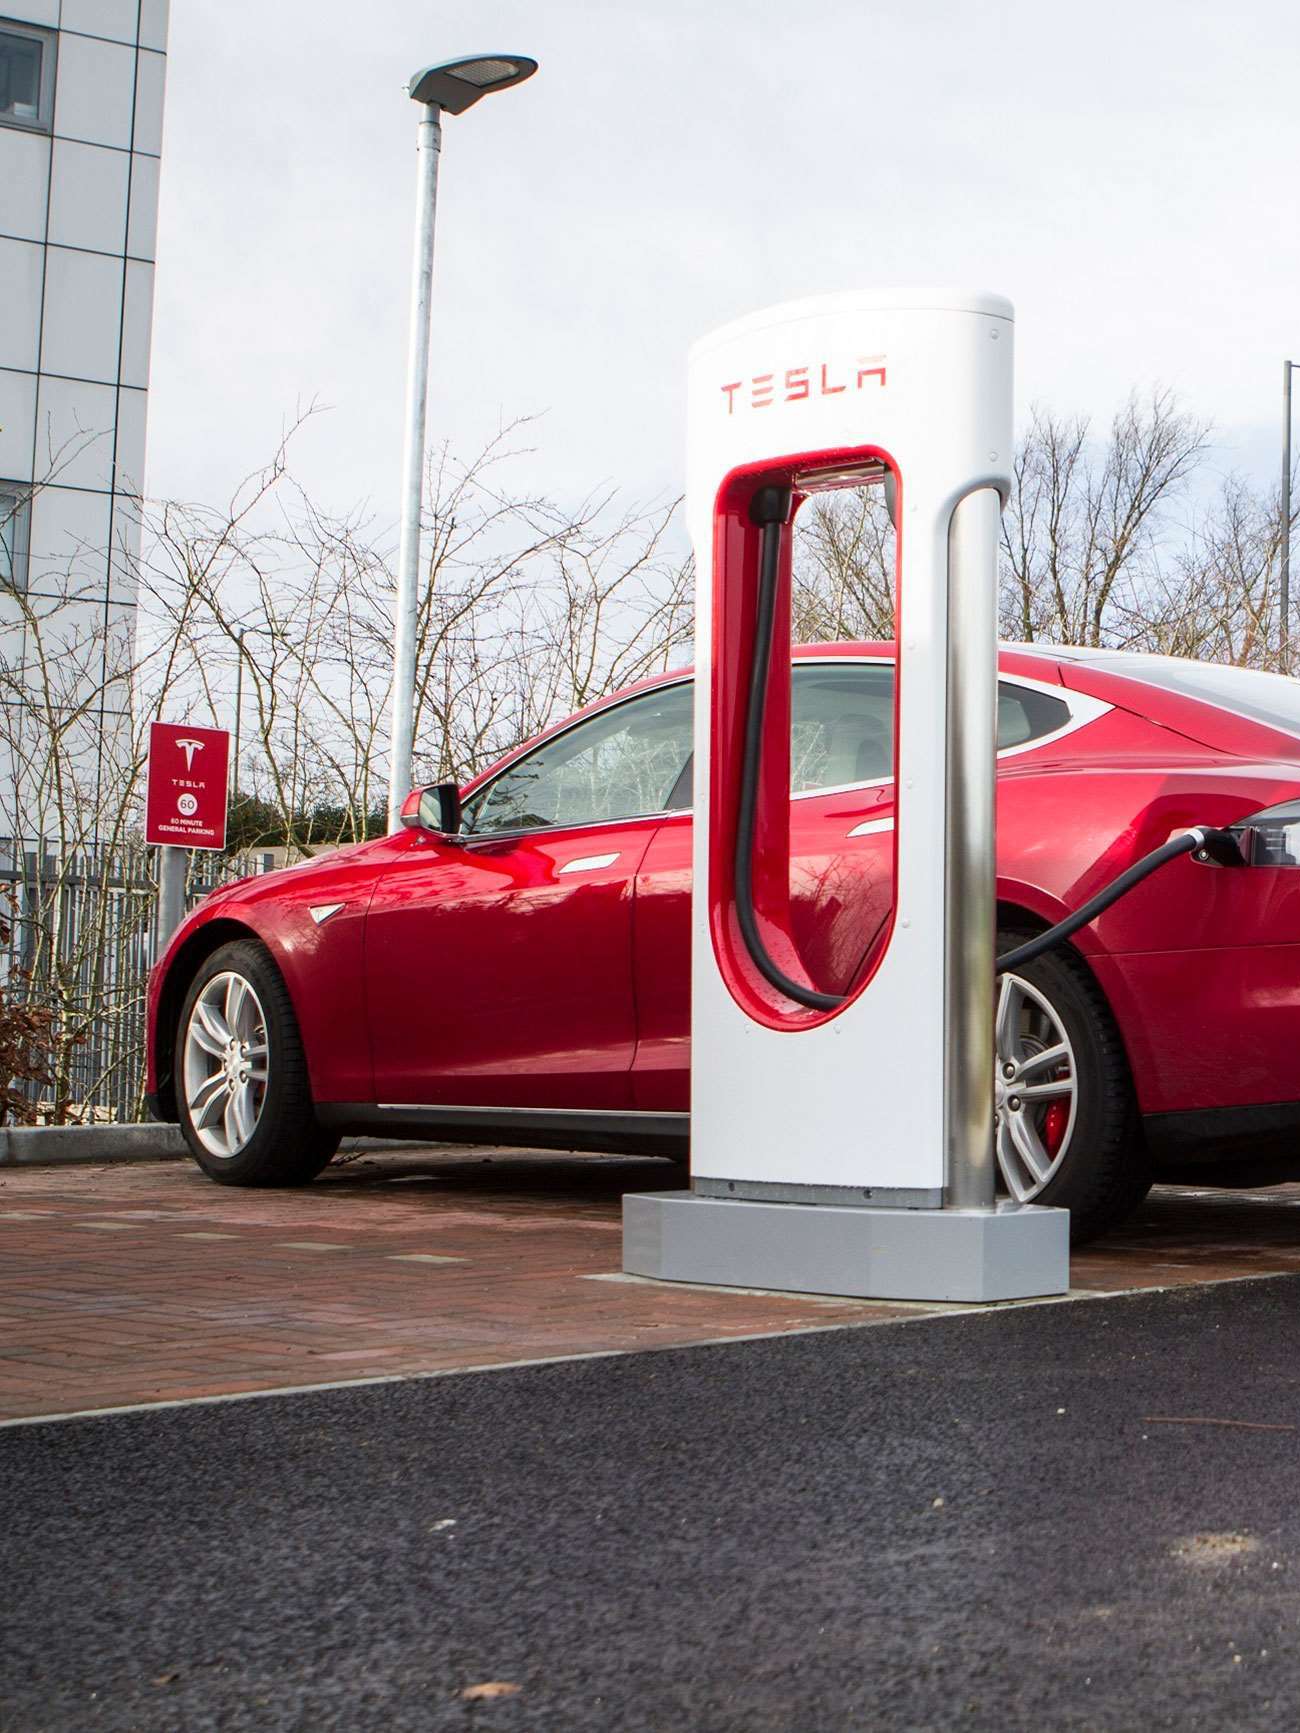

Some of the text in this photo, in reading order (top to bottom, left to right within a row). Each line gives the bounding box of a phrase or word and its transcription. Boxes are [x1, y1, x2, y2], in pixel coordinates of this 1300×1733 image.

[720, 354, 887, 415] TESLA
[171, 778, 206, 790] TESLA
[180, 799, 195, 810] 60
[180, 818, 203, 827] MINUTE
[158, 824, 215, 836] GENERAL PARKING
